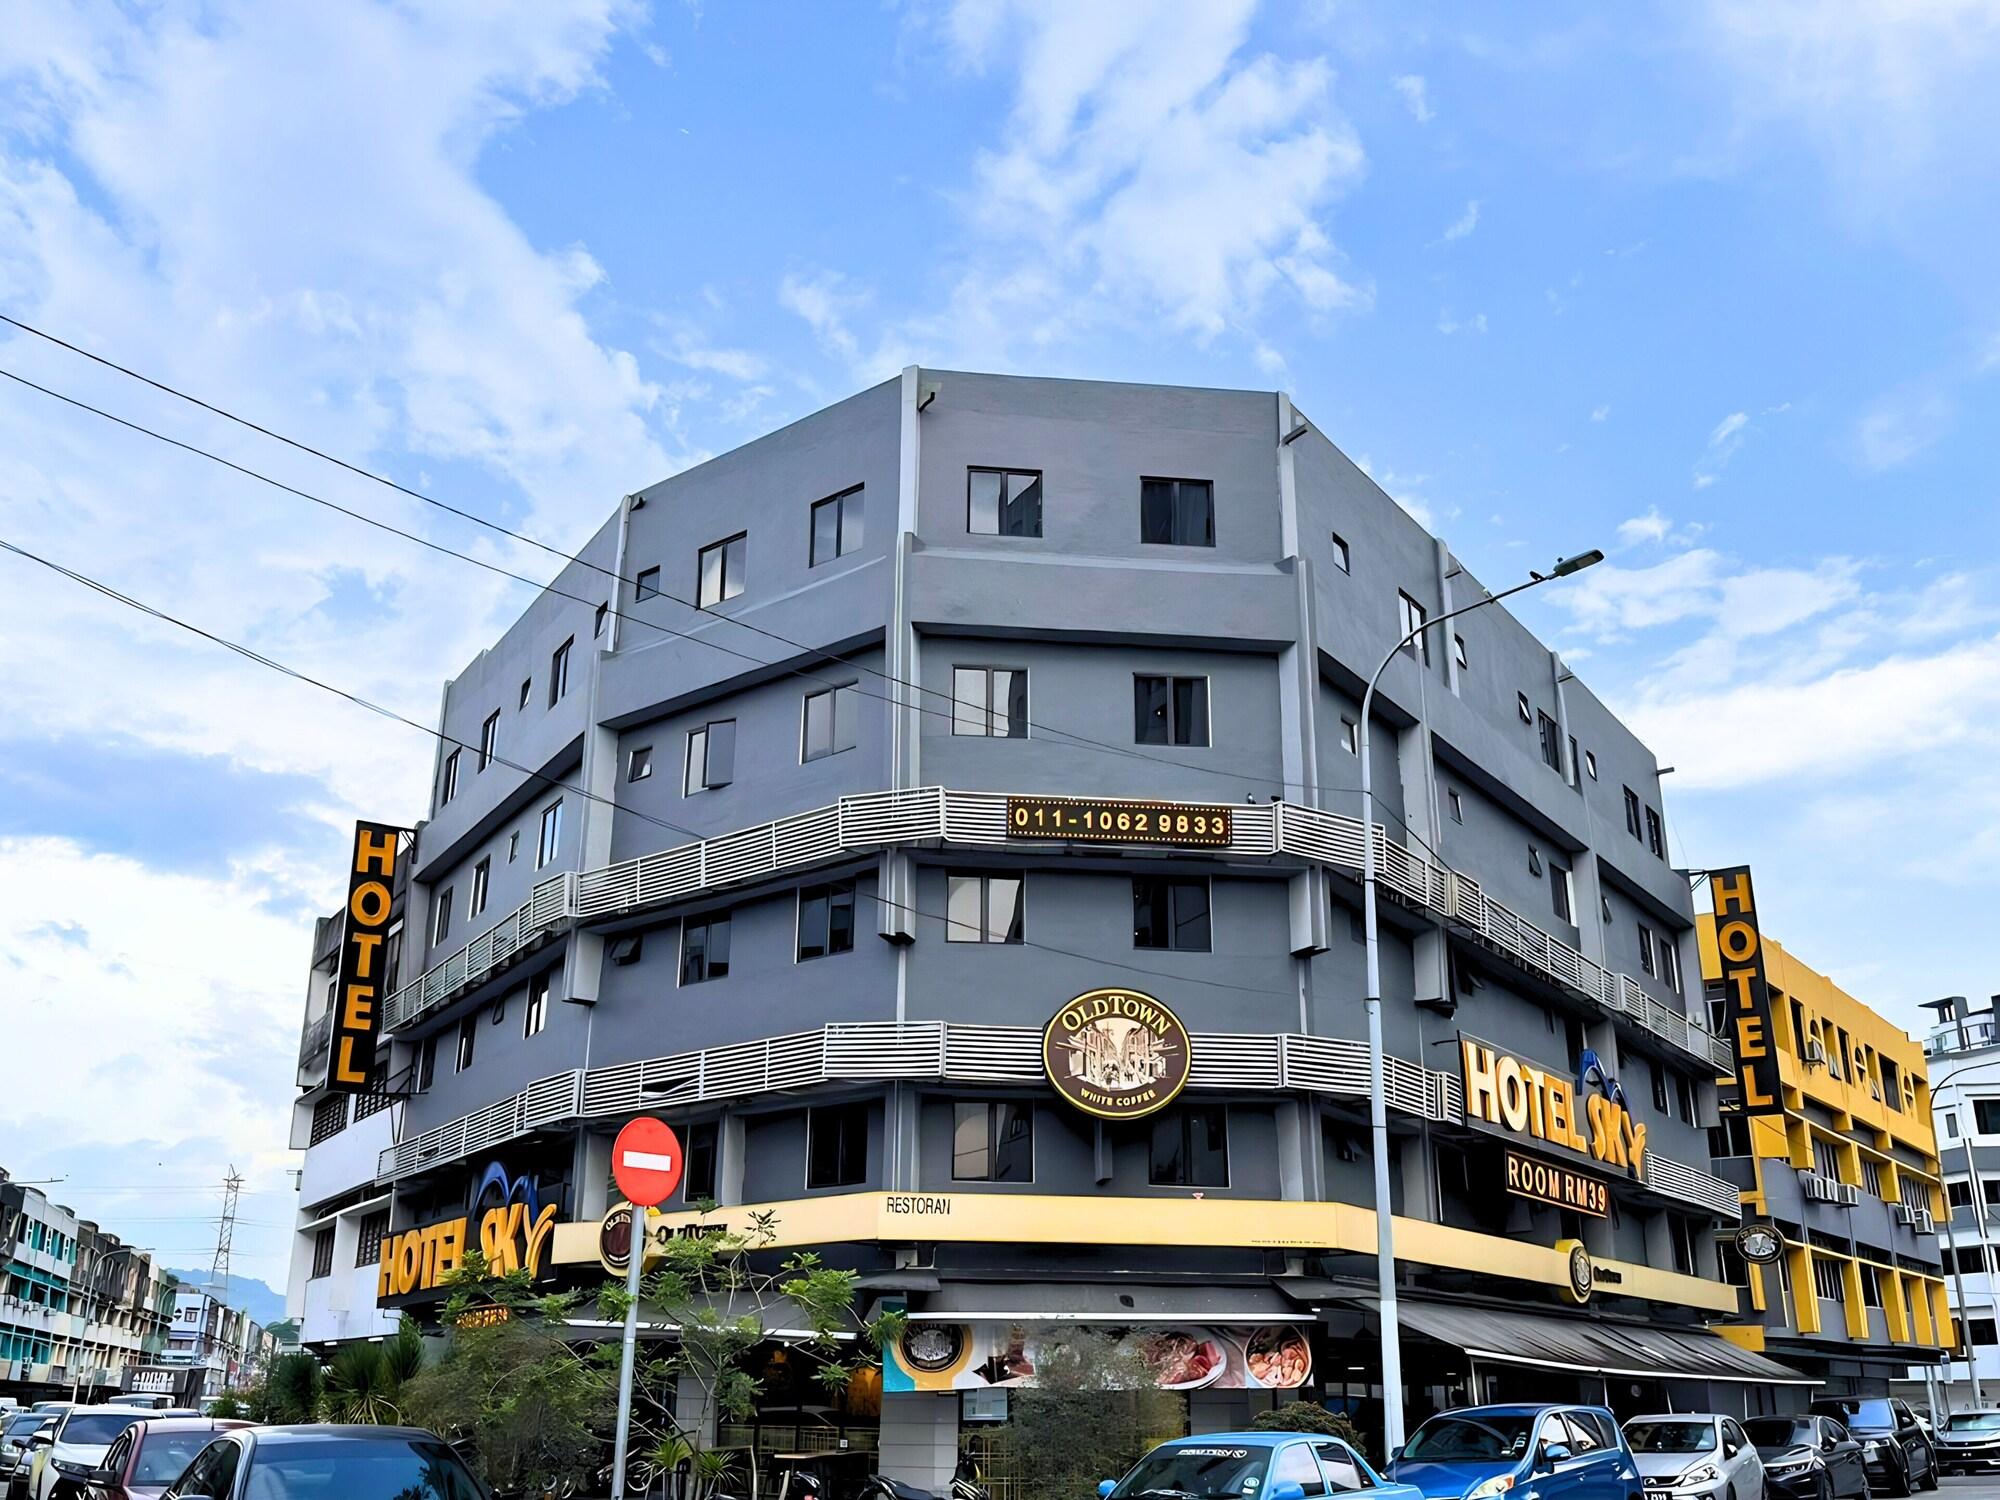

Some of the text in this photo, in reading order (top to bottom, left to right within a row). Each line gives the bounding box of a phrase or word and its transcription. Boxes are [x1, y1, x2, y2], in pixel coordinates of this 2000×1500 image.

[1015, 807, 1224, 835] 011-1062 9833
[337, 829, 397, 1084] HOTEL
[1712, 873, 1773, 1106] HOTEL
[1462, 1040, 1647, 1181] HOTEL SKY
[887, 1197, 950, 1214] RESTORAN
[1508, 1155, 1606, 1212] ROOM RM39
